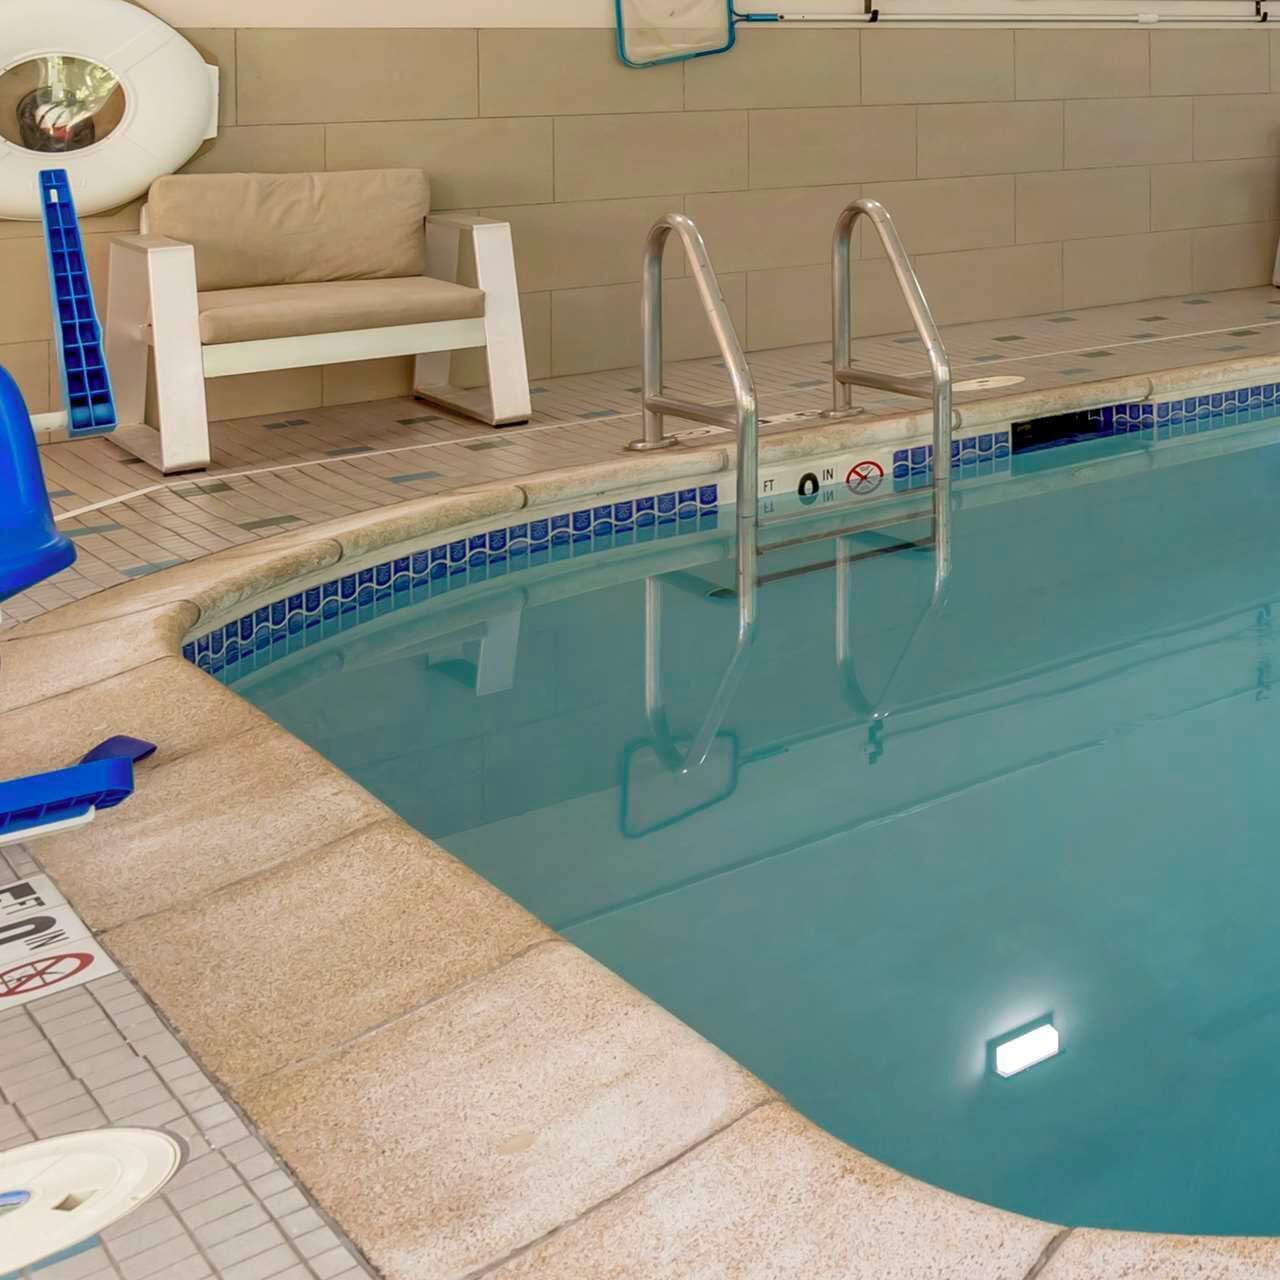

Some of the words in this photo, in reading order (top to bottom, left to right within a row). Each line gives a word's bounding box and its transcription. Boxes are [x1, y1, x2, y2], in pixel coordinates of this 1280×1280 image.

[763, 479, 774, 493] FT
[798, 472, 820, 502] 0
[822, 468, 834, 480] IN
[2, 896, 46, 915] FT
[24, 928, 70, 951] IN
